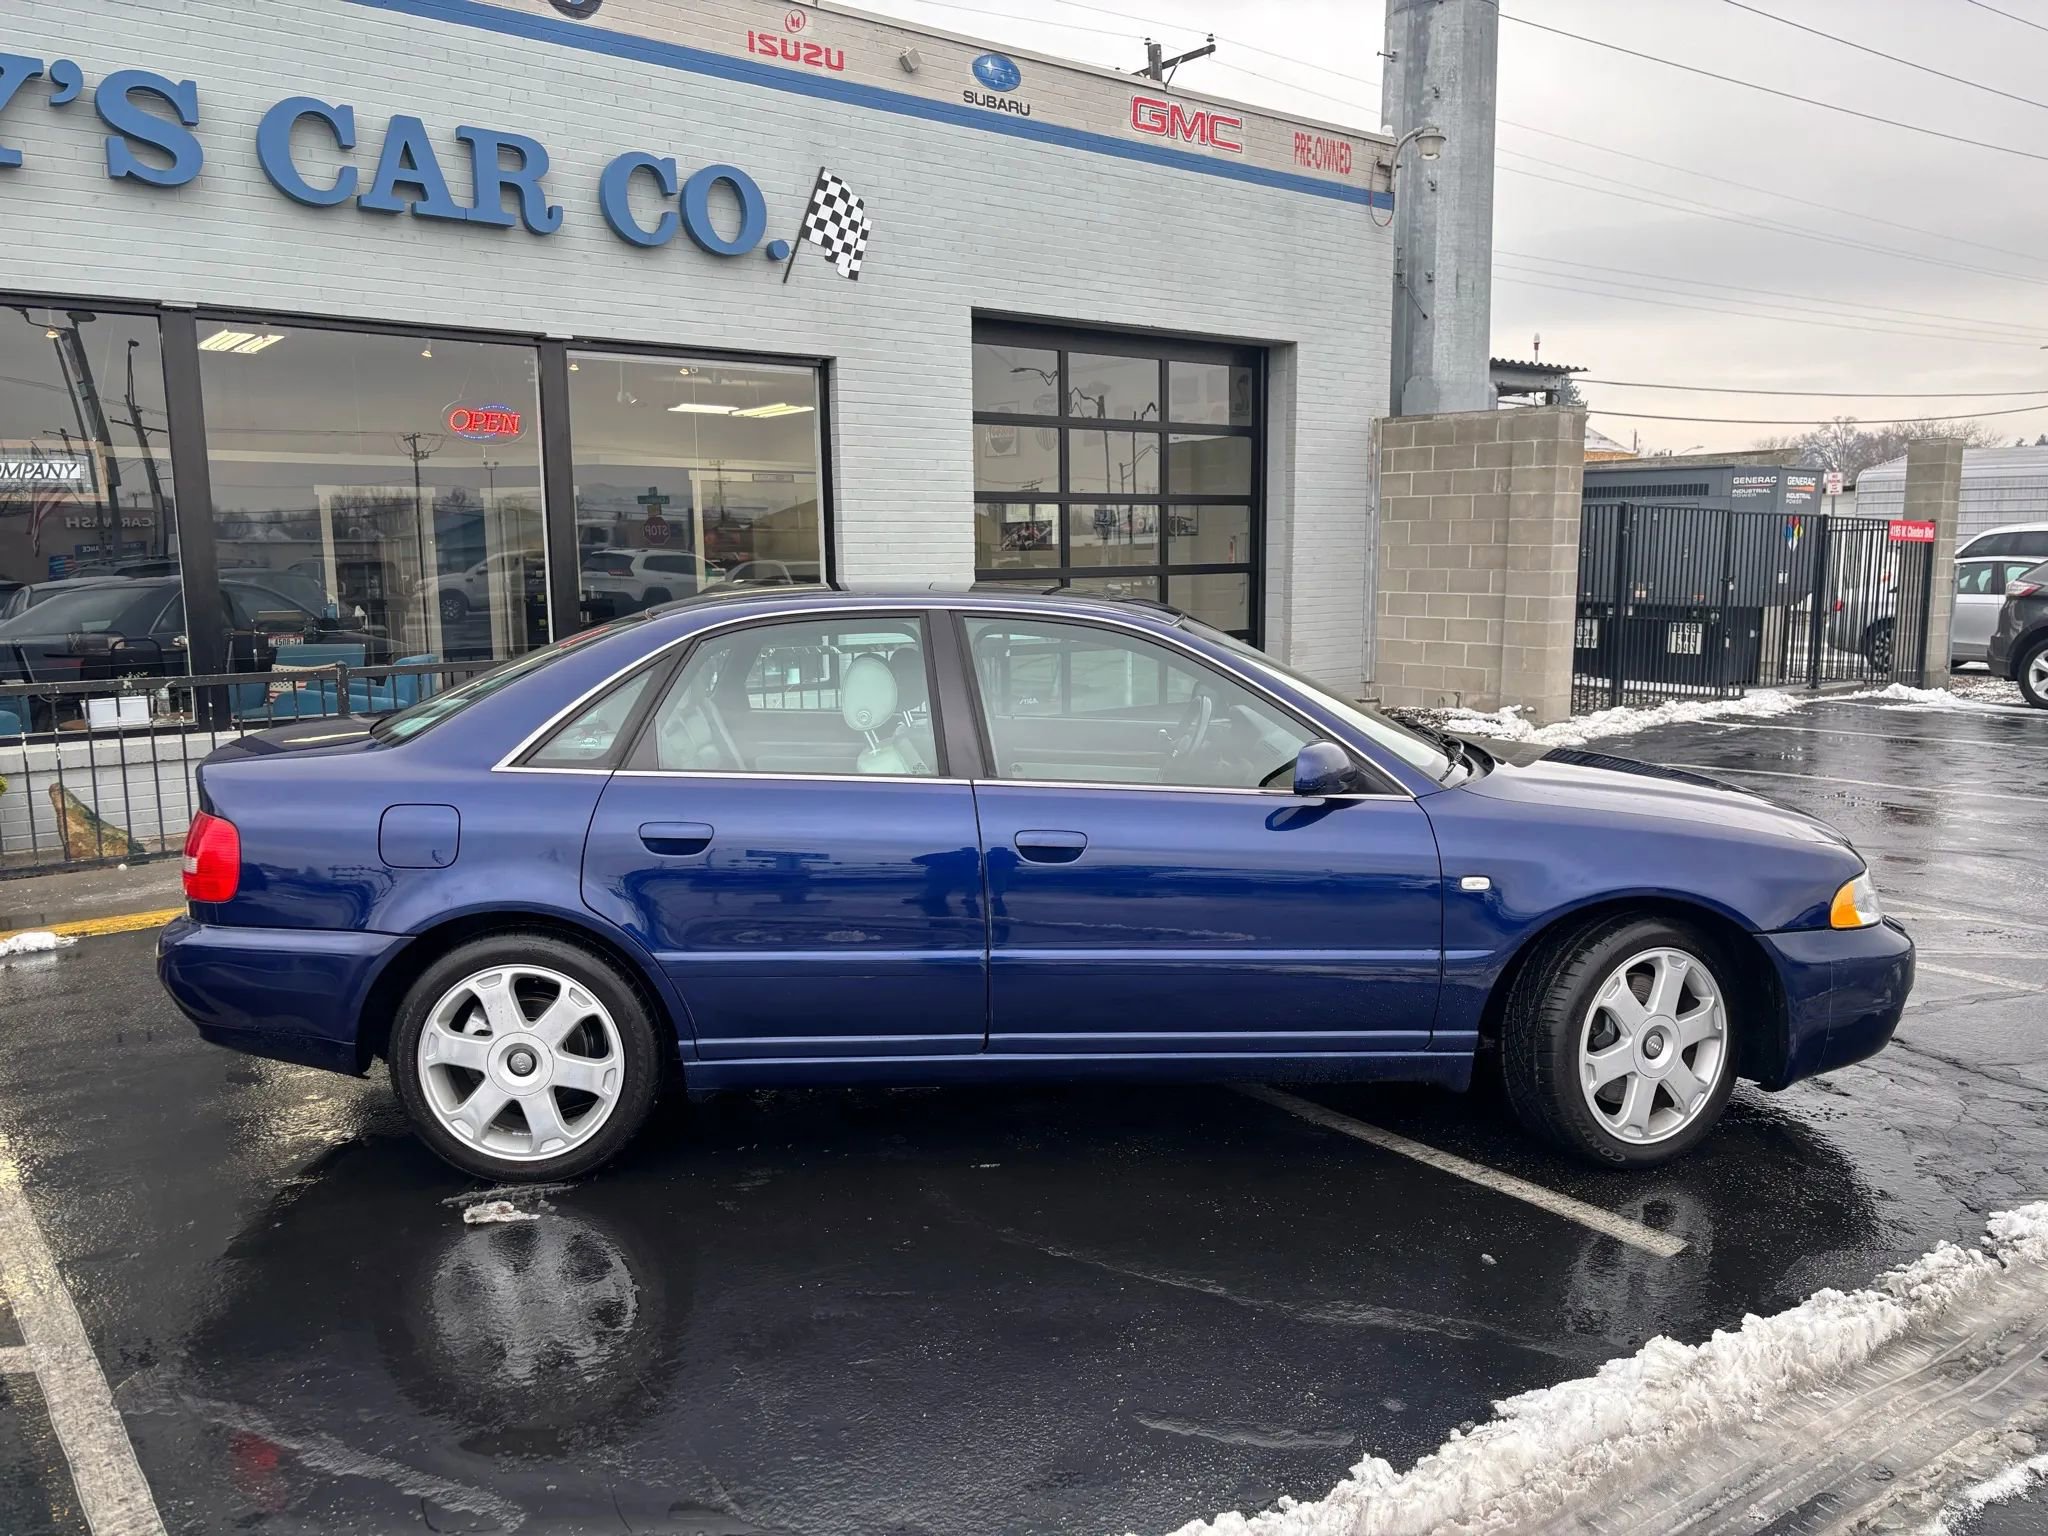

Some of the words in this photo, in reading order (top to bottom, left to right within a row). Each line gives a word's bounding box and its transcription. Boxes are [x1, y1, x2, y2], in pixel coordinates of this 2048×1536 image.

[747, 30, 845, 72] ISUZU
[962, 90, 1031, 117] SUBARU
[1130, 94, 1243, 154] GMC
[1293, 131, 1352, 175] PRE-OWNED
[256, 95, 564, 237] CAR
[600, 151, 791, 262] CO.
[450, 409, 521, 434] OPEN
[0, 462, 77, 480] MPANY
[1732, 475, 1778, 485] GENERAC
[1787, 476, 1817, 486] GENERAC
